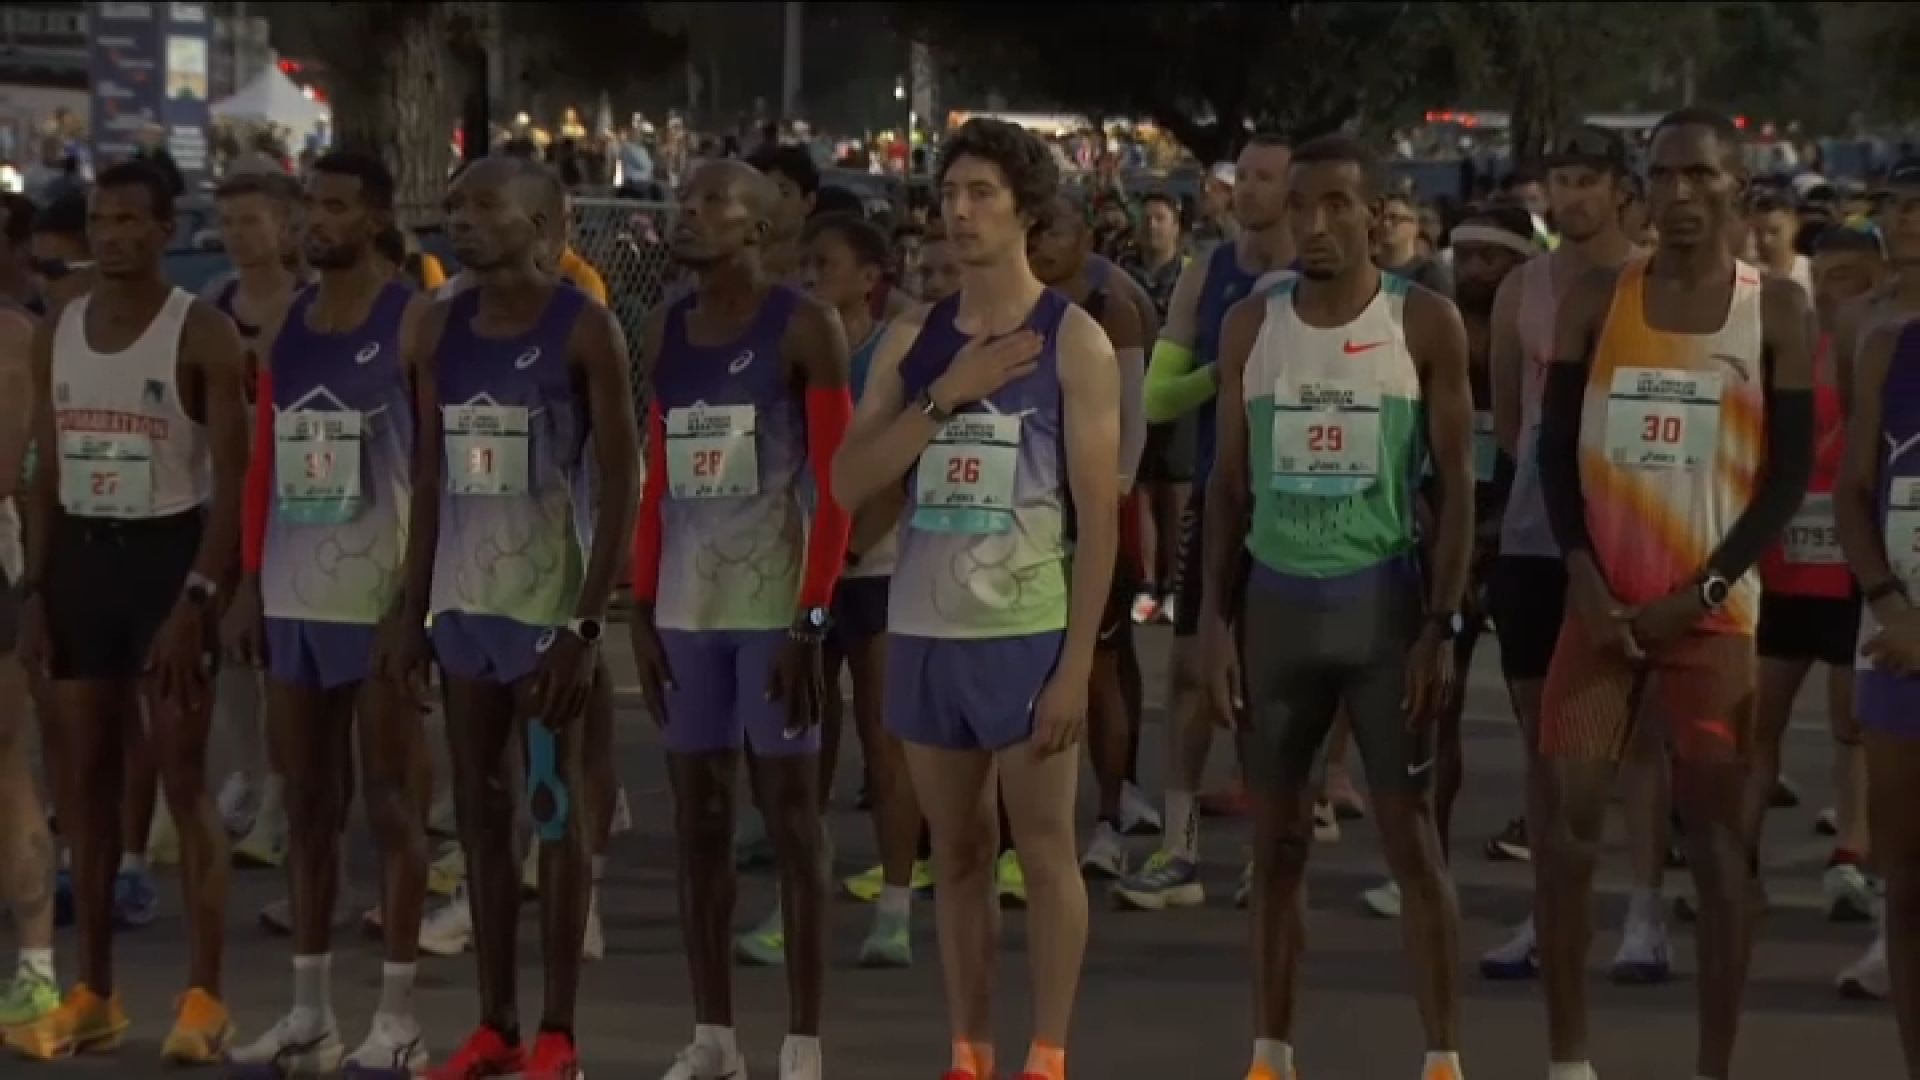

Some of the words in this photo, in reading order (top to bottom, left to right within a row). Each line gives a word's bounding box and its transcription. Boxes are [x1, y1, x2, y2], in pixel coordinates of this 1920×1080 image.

[1308, 425, 1342, 452] 29
[1641, 415, 1681, 443] 30
[946, 457, 980, 484] 26
